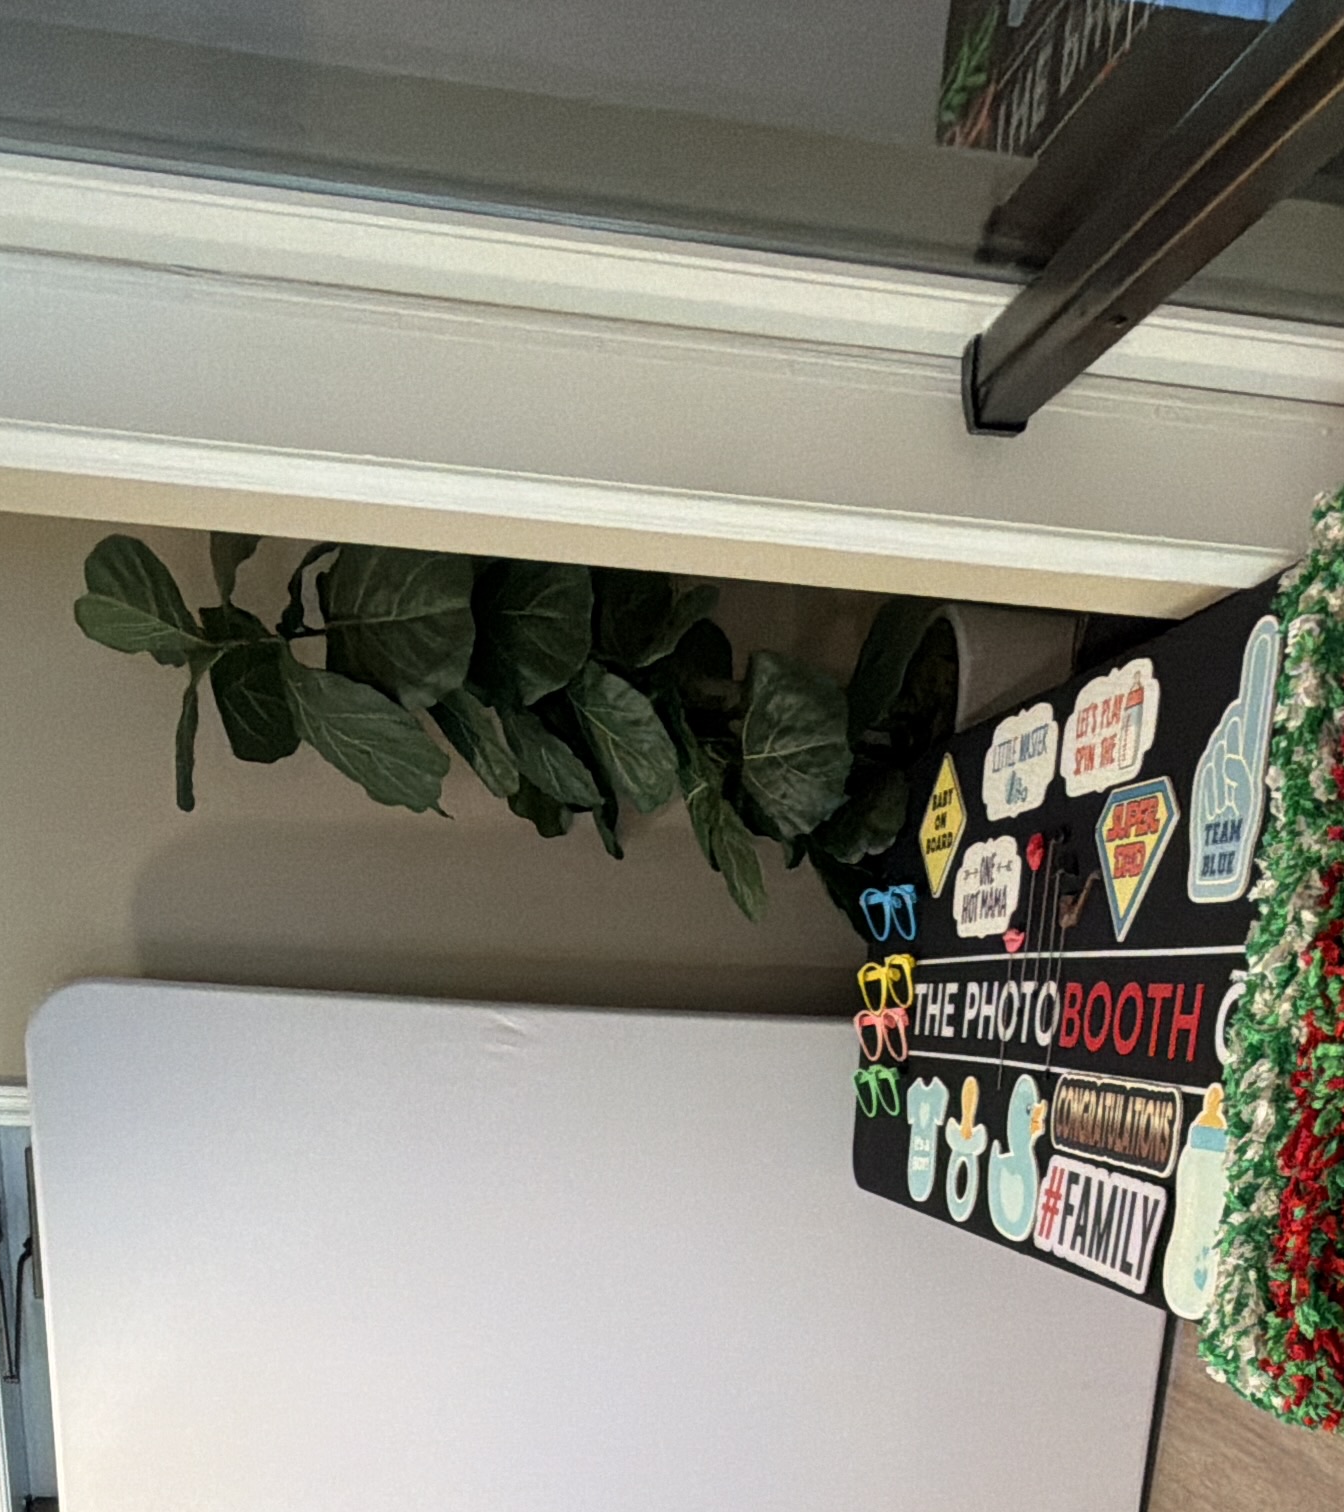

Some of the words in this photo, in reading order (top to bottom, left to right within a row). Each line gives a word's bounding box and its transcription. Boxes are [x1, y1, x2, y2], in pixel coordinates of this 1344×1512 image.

[992, 736, 1019, 773] LITTLE
[1074, 744, 1095, 775] SPIN
[932, 787, 954, 811] BABY
[934, 812, 947, 831] ON
[1106, 795, 1160, 842] SUPER
[1204, 818, 1243, 847] TEAM
[926, 832, 953, 854] BOARD
[1113, 840, 1146, 879] DAD
[1201, 852, 1236, 877] BLUE
[961, 890, 979, 924] HOT
[980, 885, 1007, 919] MAMA
[913, 982, 958, 1038] THE
[1057, 1085, 1173, 1163] CONGRATULATIONS
[1037, 1166, 1160, 1281] #FAMILY
